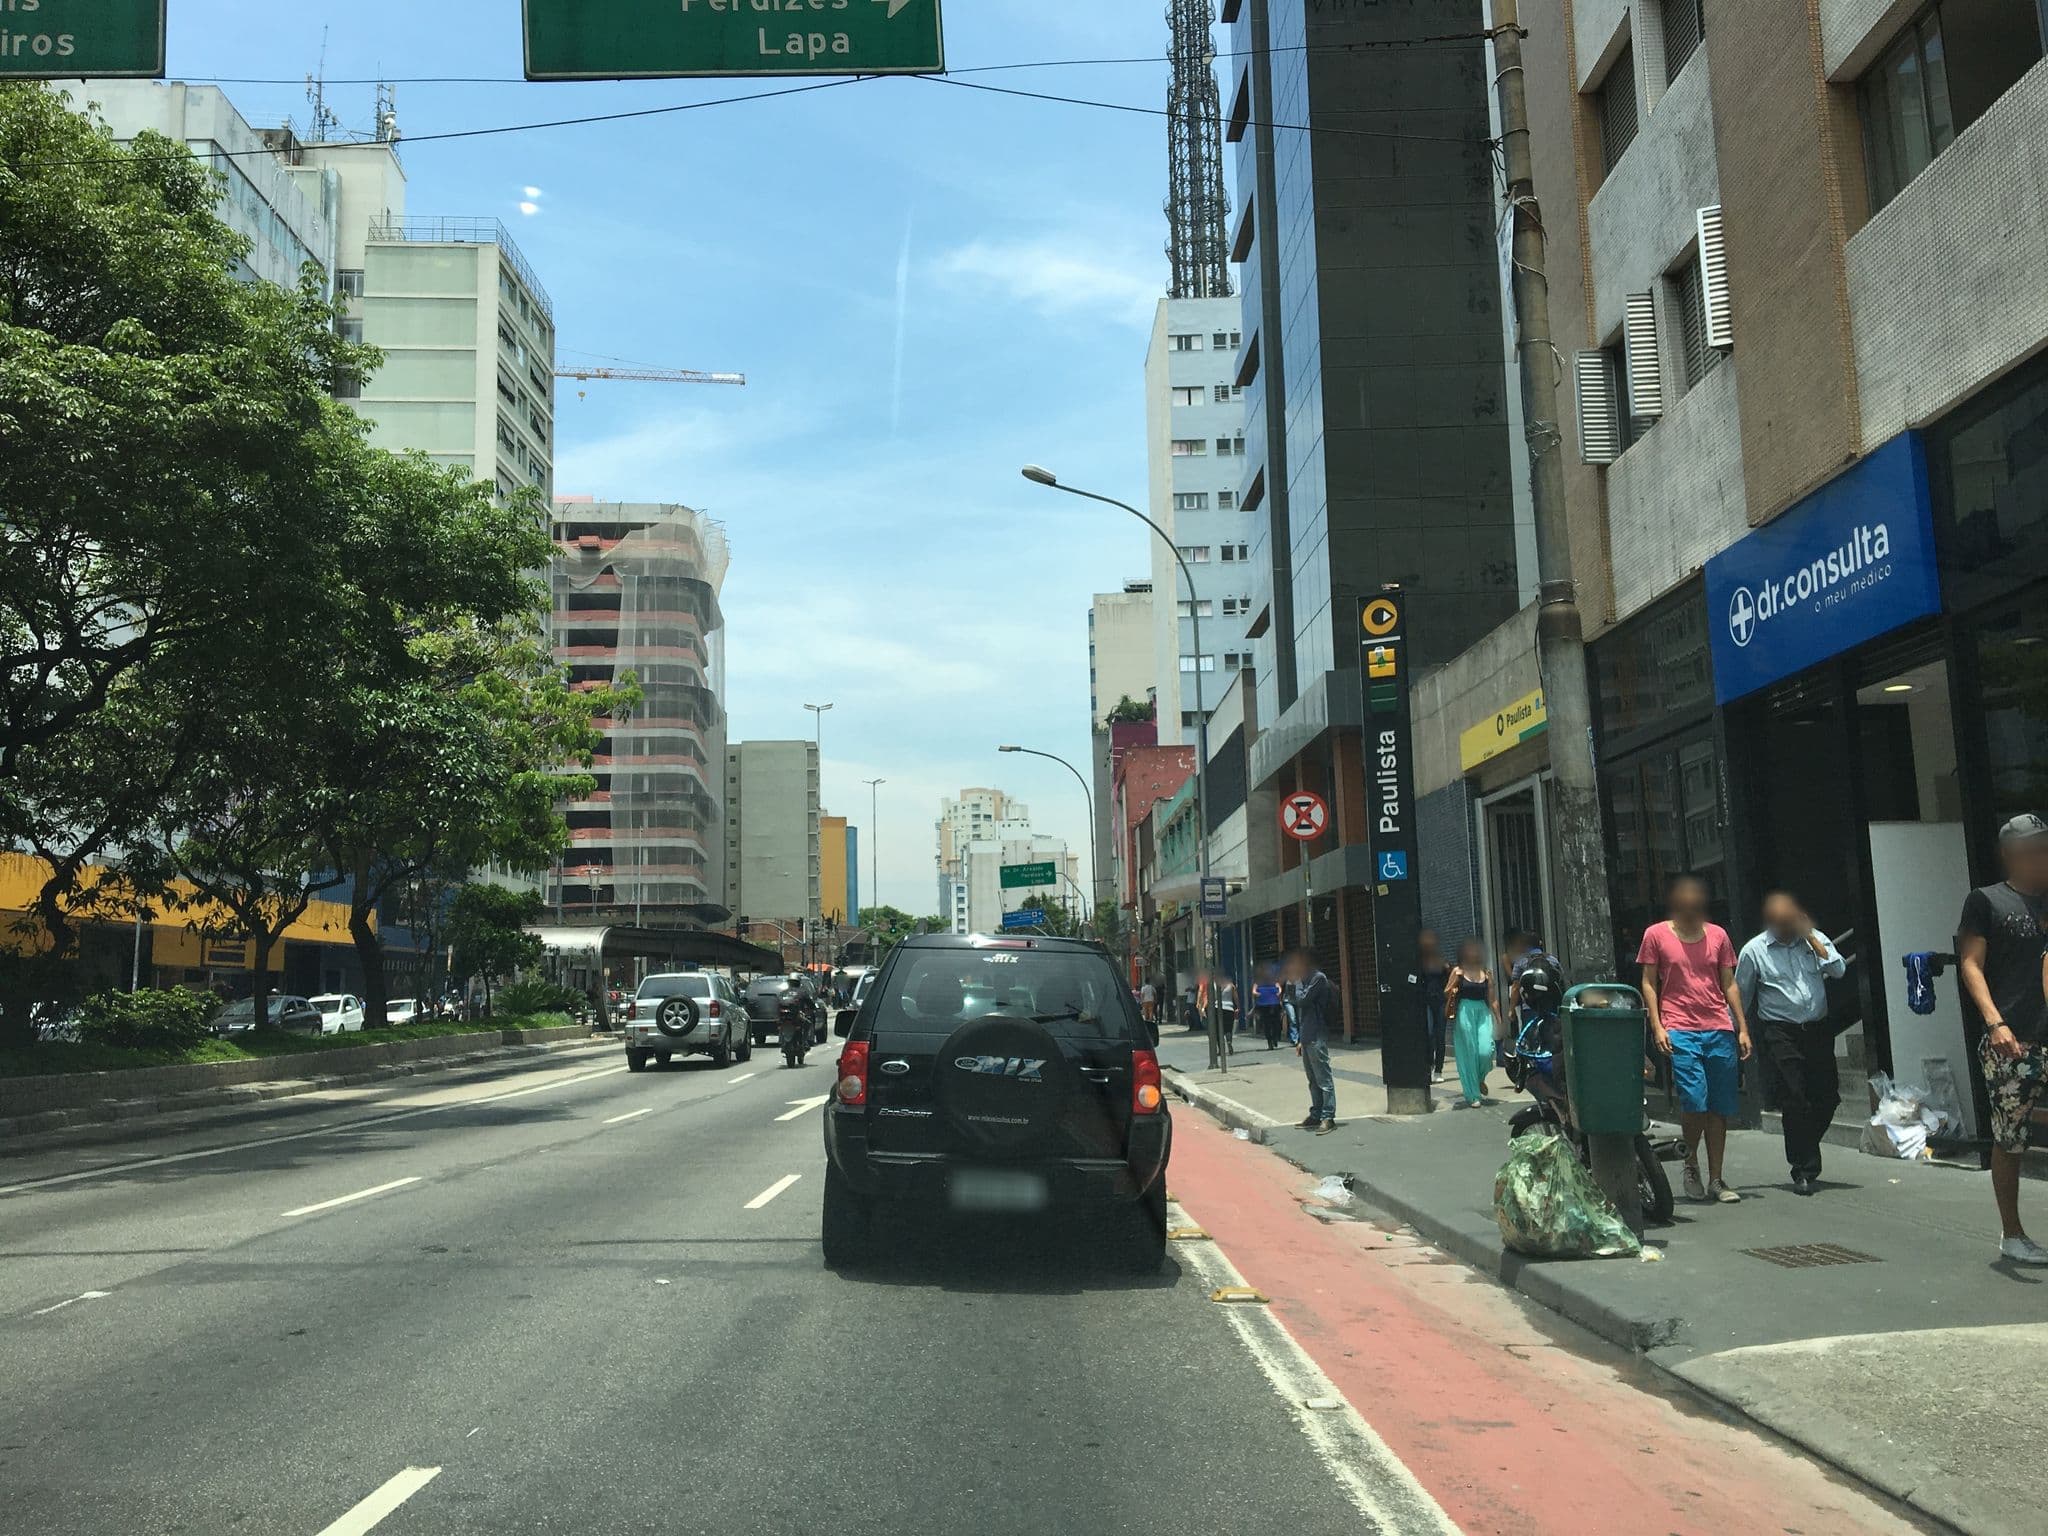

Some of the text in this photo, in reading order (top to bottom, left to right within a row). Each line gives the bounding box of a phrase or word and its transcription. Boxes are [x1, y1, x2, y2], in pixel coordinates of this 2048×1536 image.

[758, 27, 850, 61] Lapa
[1757, 522, 1890, 621] dr.consulta
[1814, 601, 1821, 613] o
[1824, 588, 1847, 609] meu
[1506, 704, 1532, 728] Paulista
[1377, 730, 1401, 833] Paulista
